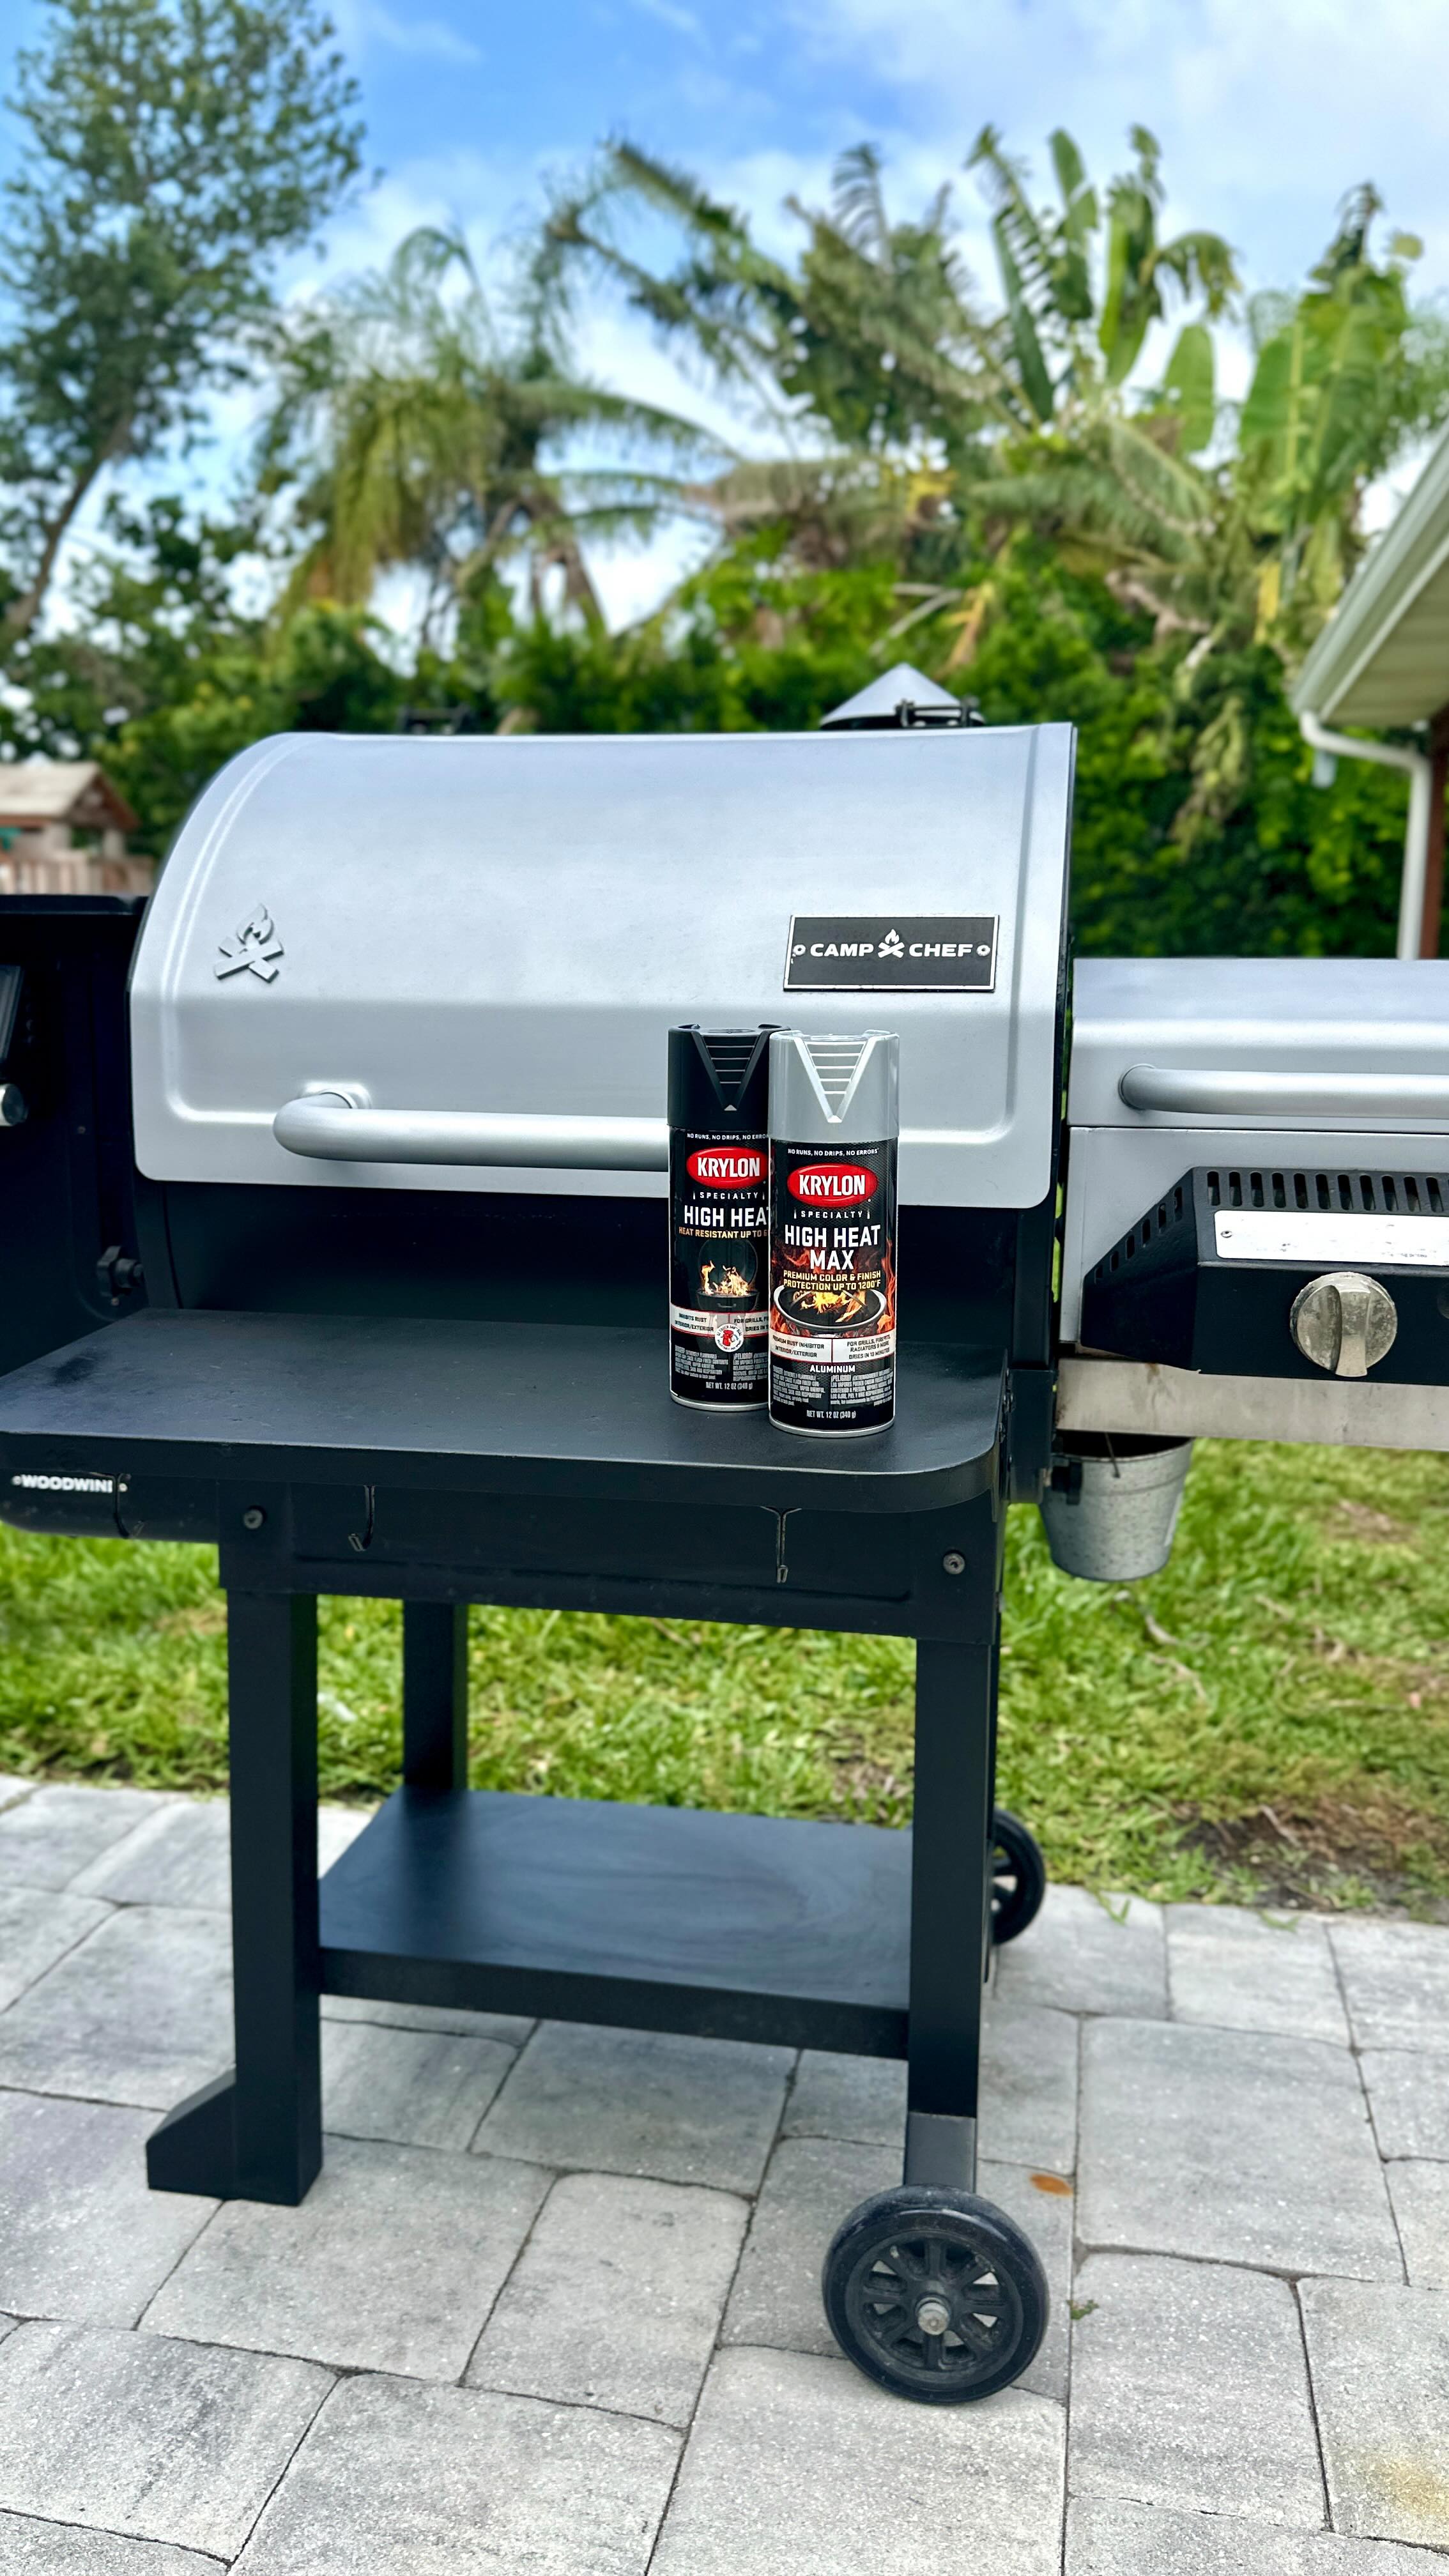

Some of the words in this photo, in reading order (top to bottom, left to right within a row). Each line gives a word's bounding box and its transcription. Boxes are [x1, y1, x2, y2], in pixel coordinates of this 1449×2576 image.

[810, 944, 873, 957] CAMP
[909, 944, 973, 957] CHEF
[698, 1157, 760, 1177] KRYLON
[799, 1174, 866, 1196] KRYLON
[700, 1192, 758, 1200] SPECIALTY
[684, 1205, 724, 1227] HIGH
[731, 1206, 770, 1227] HEA
[801, 1210, 862, 1218] SPECIALTY
[678, 1227, 694, 1236] HEAT
[695, 1229, 739, 1239] RESISTANT
[785, 1224, 827, 1248] HIGH
[834, 1224, 881, 1248] HEAT
[810, 1249, 854, 1270] MAX
[783, 1269, 817, 1281] PREMIUM
[819, 1273, 848, 1282] COLOR
[857, 1269, 881, 1280] FINISH
[783, 1278, 830, 1291] PROTECTION
[833, 1282, 845, 1291] UP
[846, 1282, 857, 1291] TO
[809, 1365, 855, 1373] ALUMINUM
[806, 1409, 815, 1418] NET
[833, 1411, 839, 1419] OZ
